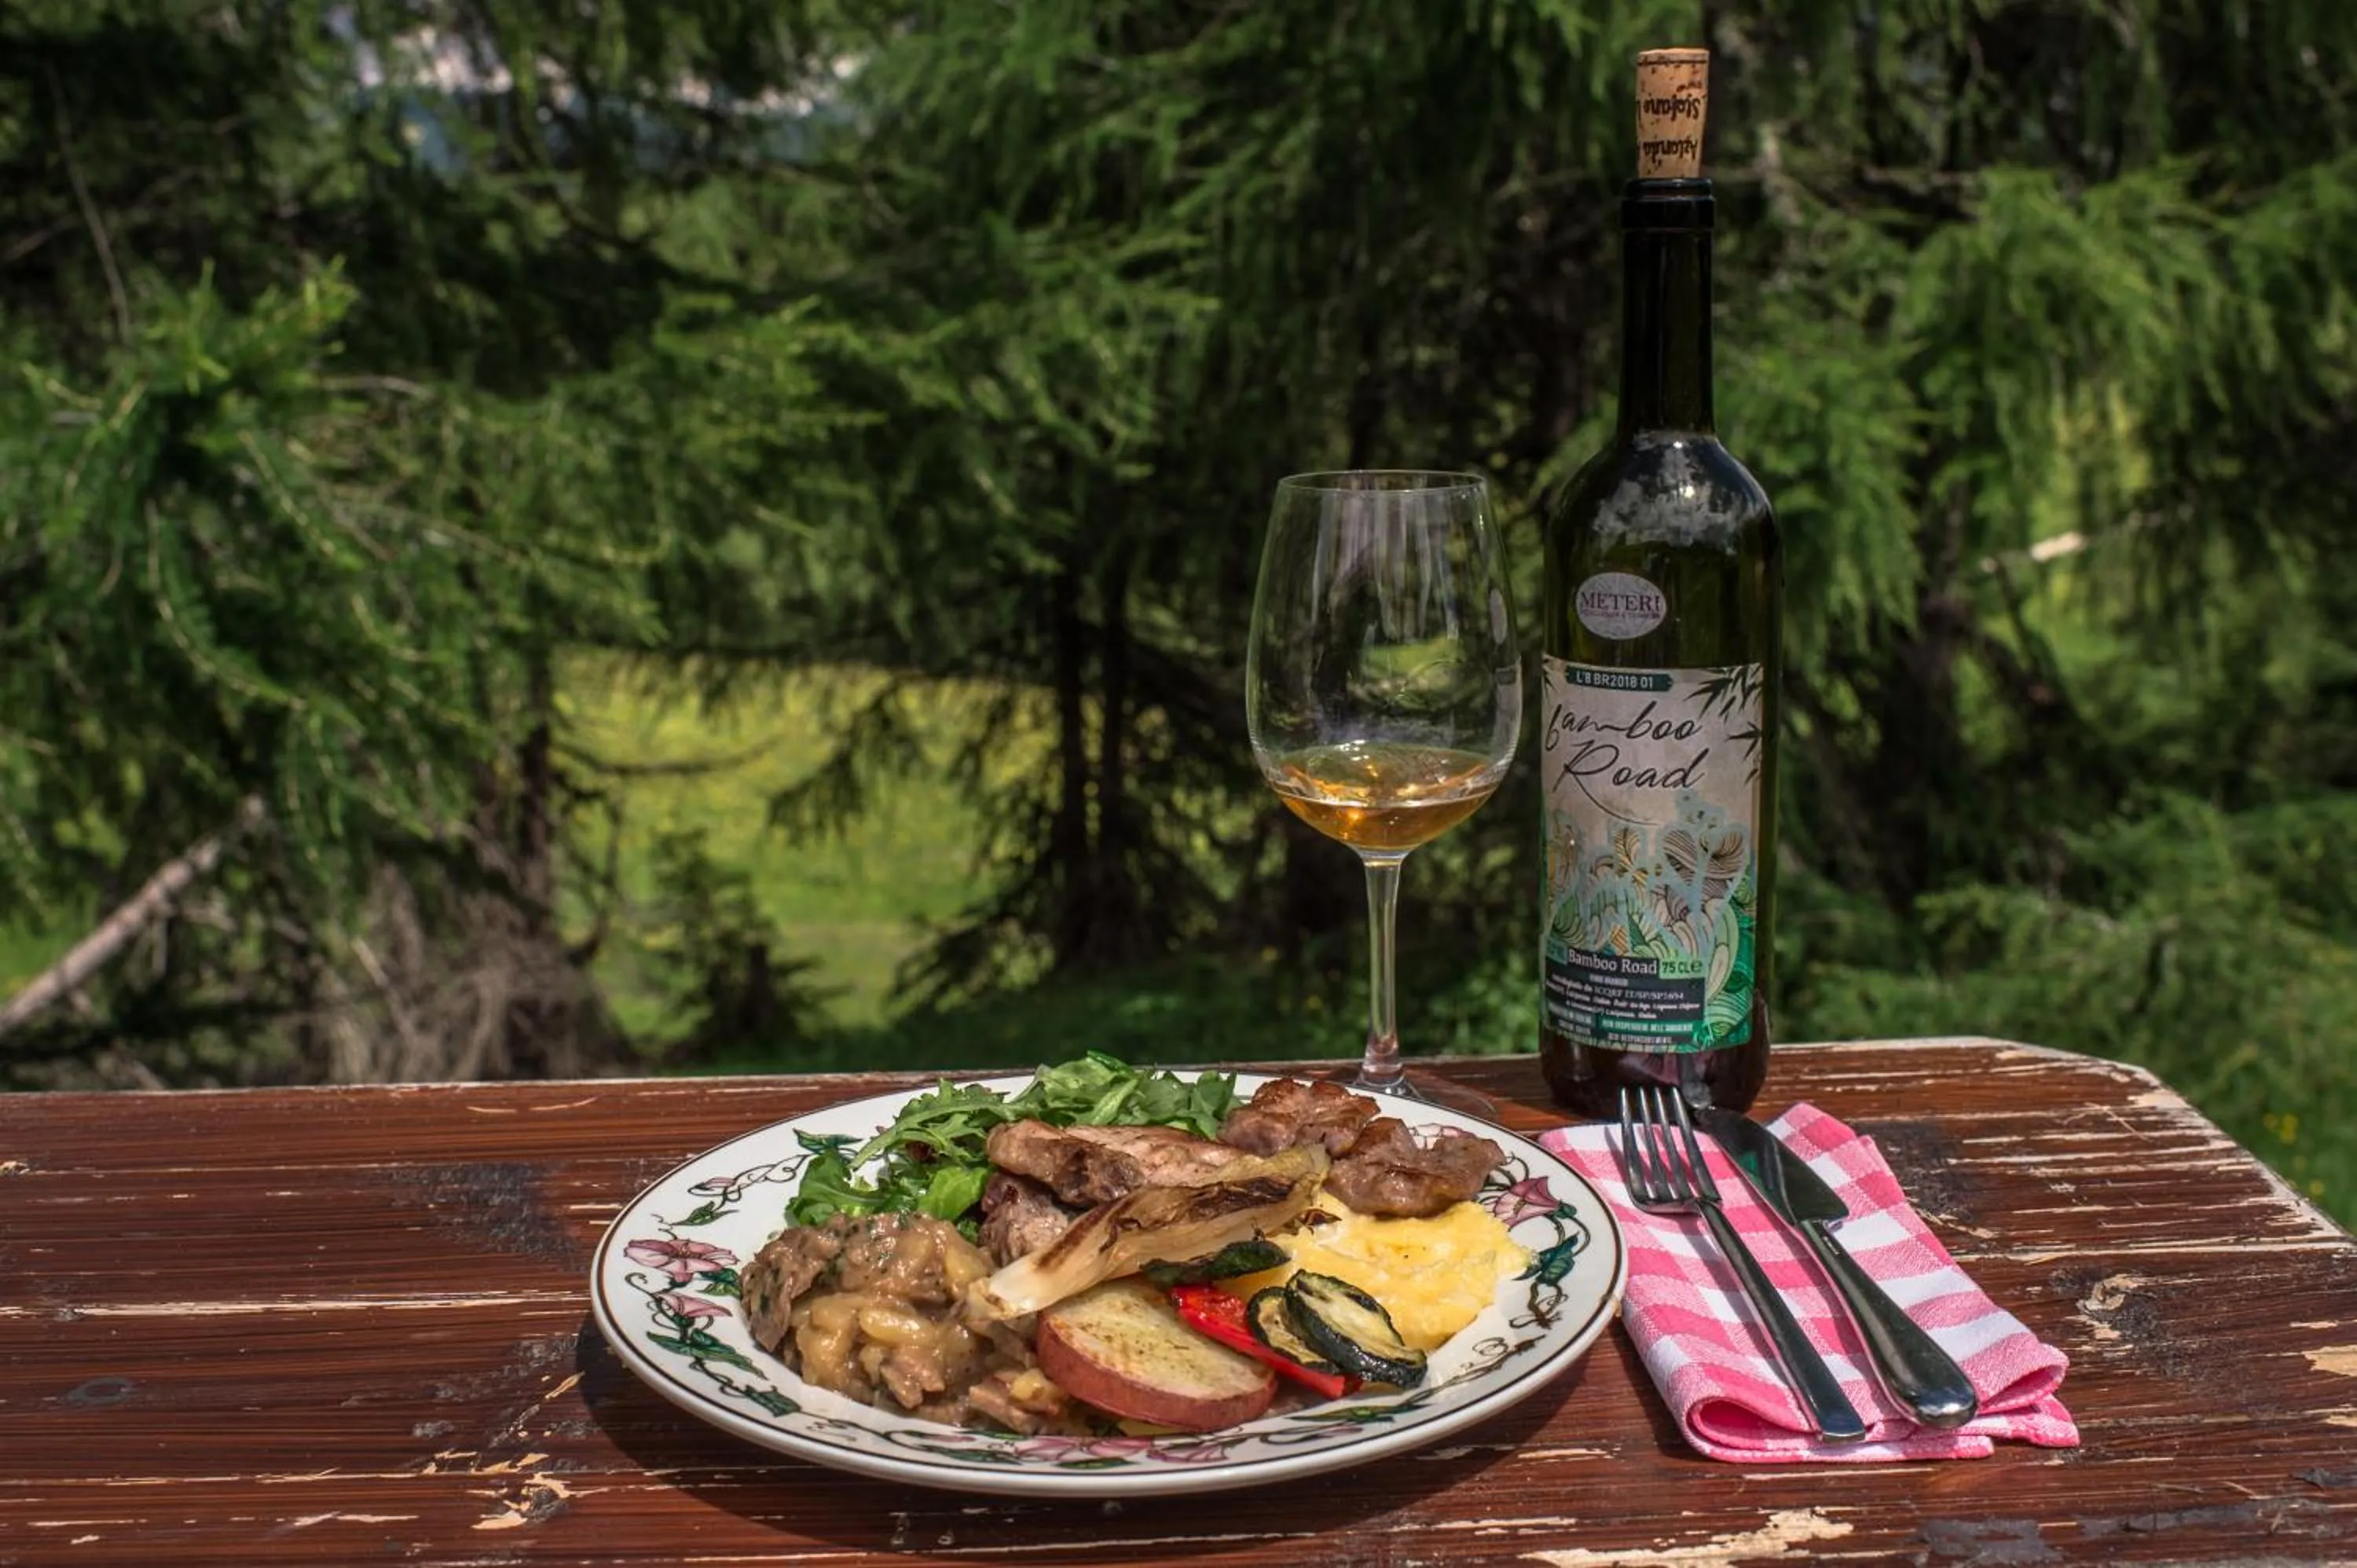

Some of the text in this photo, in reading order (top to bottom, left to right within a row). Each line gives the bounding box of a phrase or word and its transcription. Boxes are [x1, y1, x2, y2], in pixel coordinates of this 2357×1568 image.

[1552, 739, 1710, 826] Road
[1569, 948, 1618, 972] Bamboo
[1621, 958, 1658, 975] Road
